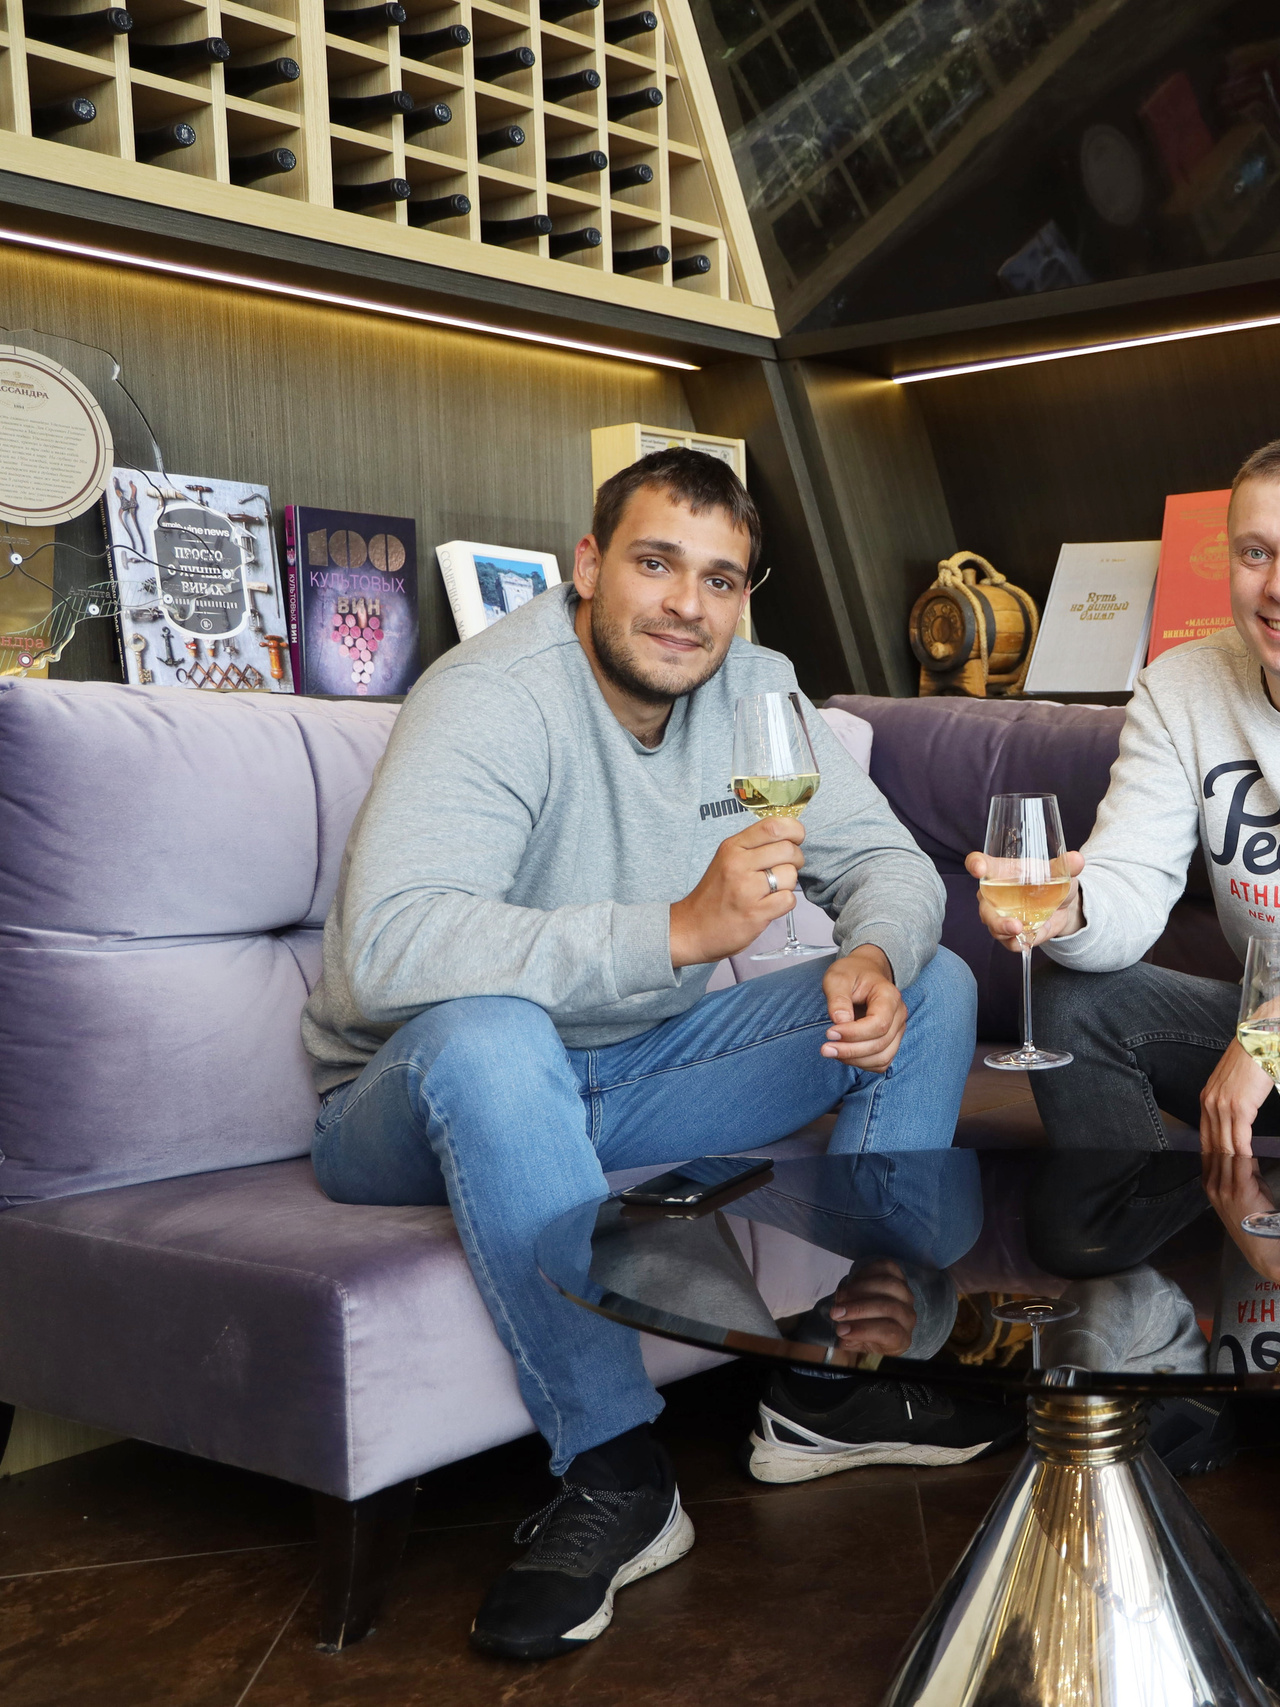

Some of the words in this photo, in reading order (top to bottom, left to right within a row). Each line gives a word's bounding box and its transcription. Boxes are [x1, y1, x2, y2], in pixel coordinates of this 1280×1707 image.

[204, 527, 230, 537] news
[174, 546, 223, 562] ПРОСТО
[307, 528, 406, 572] 100
[167, 564, 177, 576] О
[180, 564, 235, 580] ЛУЧШИ
[310, 571, 406, 593] КУЛЬТОВЫХ
[195, 599, 238, 609] НЦИКЛОПЕДИЯ
[288, 573, 297, 622] КУЛЬТОВЫХ
[1086, 592, 1117, 604] Путь
[337, 597, 381, 615] ВИН
[1070, 604, 1084, 612] на
[1163, 629, 1195, 638] ВИННАЯ
[1249, 909, 1275, 924] NEW
